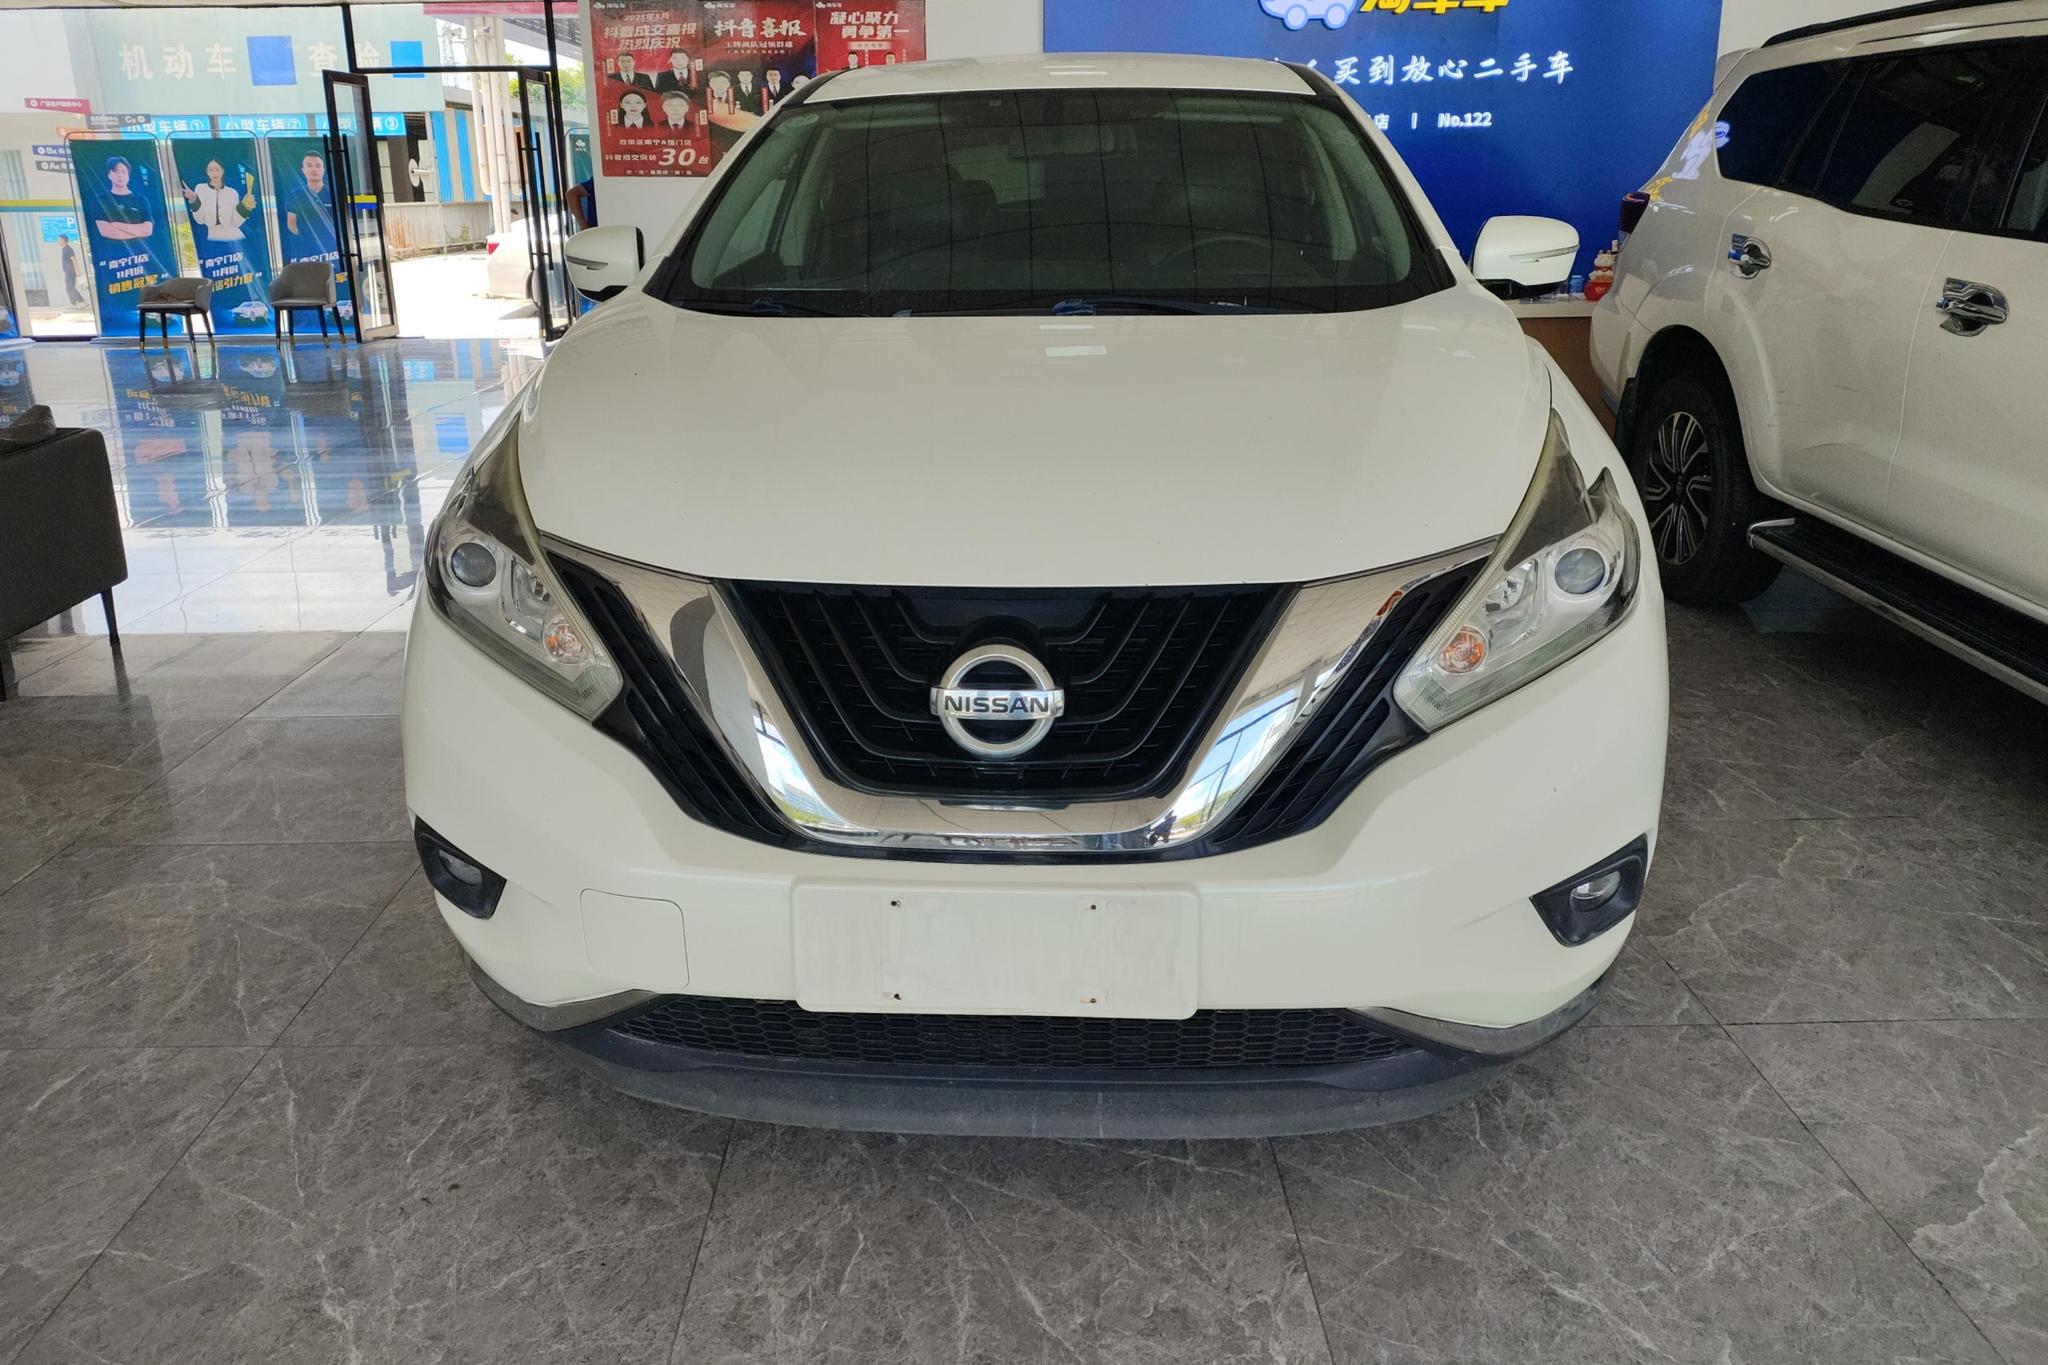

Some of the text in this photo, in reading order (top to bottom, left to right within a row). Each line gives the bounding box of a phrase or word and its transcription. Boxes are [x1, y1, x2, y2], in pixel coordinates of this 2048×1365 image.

[714, 17, 807, 38] 抖音喜报
[829, 11, 899, 25] 凝心聚力
[118, 42, 237, 81] 机动车
[1273, 51, 1573, 85] 买到放心二手车
[944, 695, 1049, 713] NISSAN
